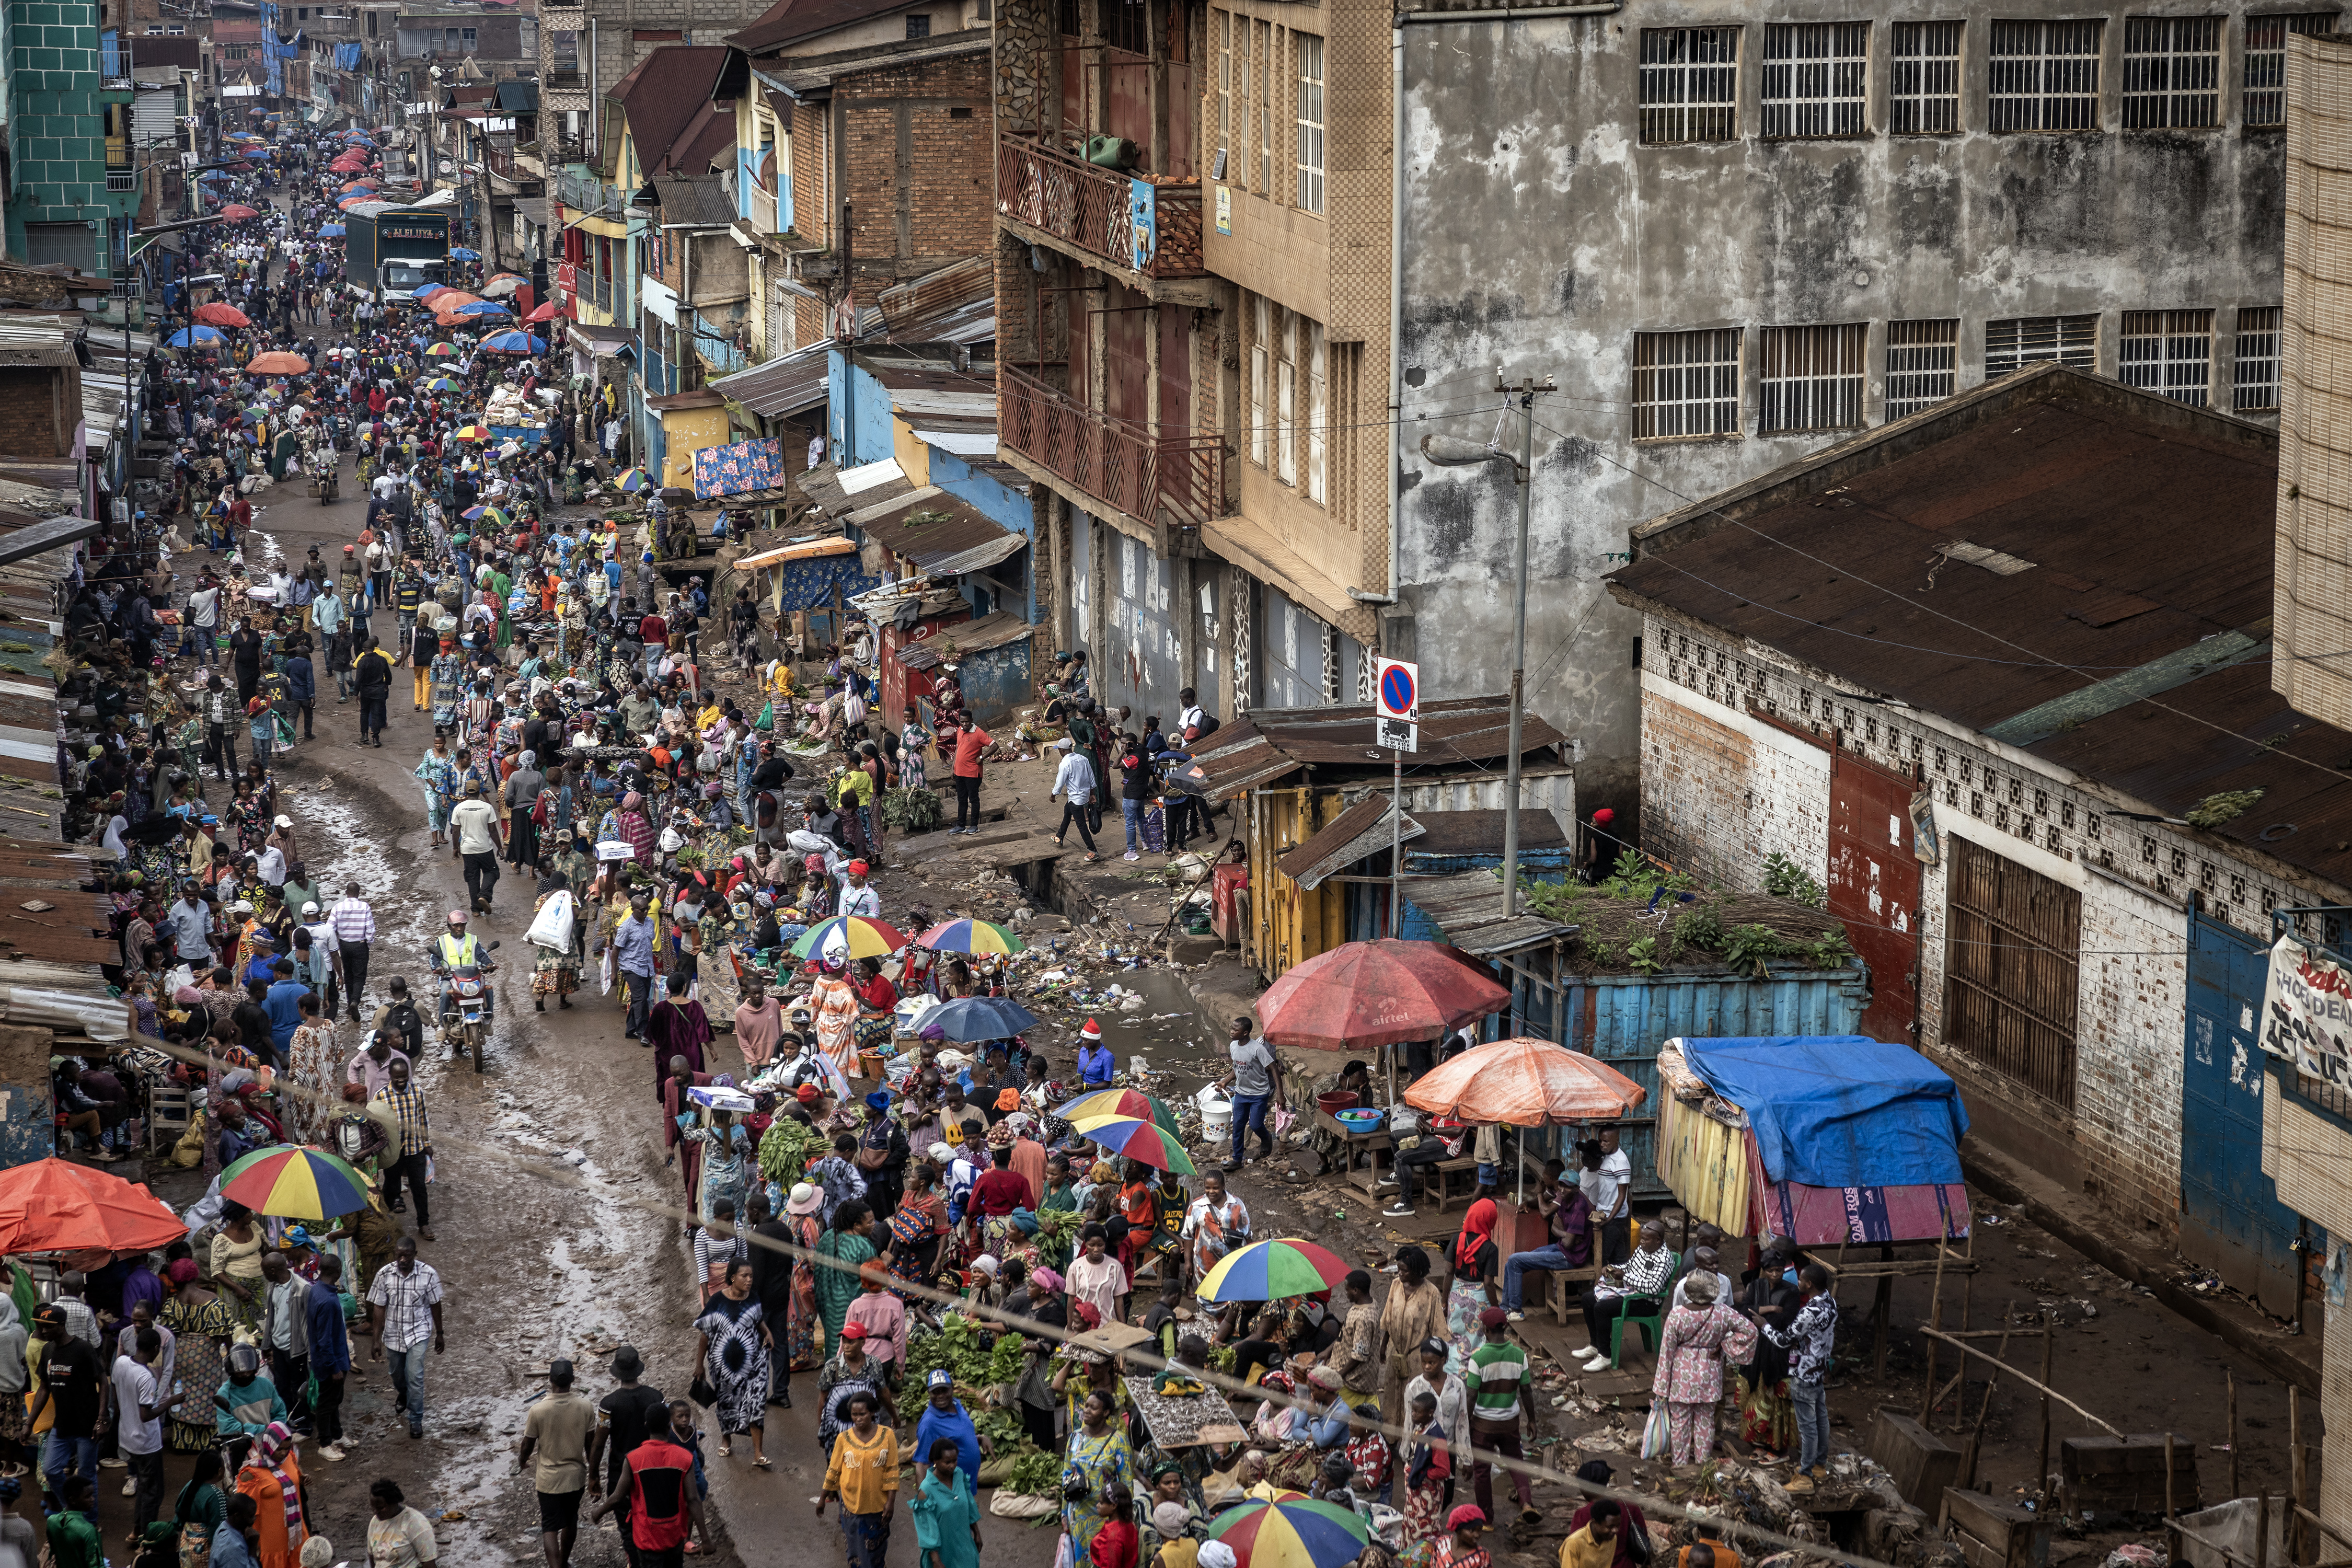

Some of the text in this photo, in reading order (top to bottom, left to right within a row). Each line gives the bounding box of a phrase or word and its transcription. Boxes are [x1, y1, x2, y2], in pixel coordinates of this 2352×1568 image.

[393, 228, 434, 238] ALELUYA
[869, 558, 888, 568] airtel
[2276, 967, 2310, 1009] SHOES
[1372, 1012, 1410, 1026] airtel
[1844, 1187, 1857, 1212] ROS
[1163, 1209, 1183, 1219] LAKERS
[1849, 1215, 1862, 1243] OAM
